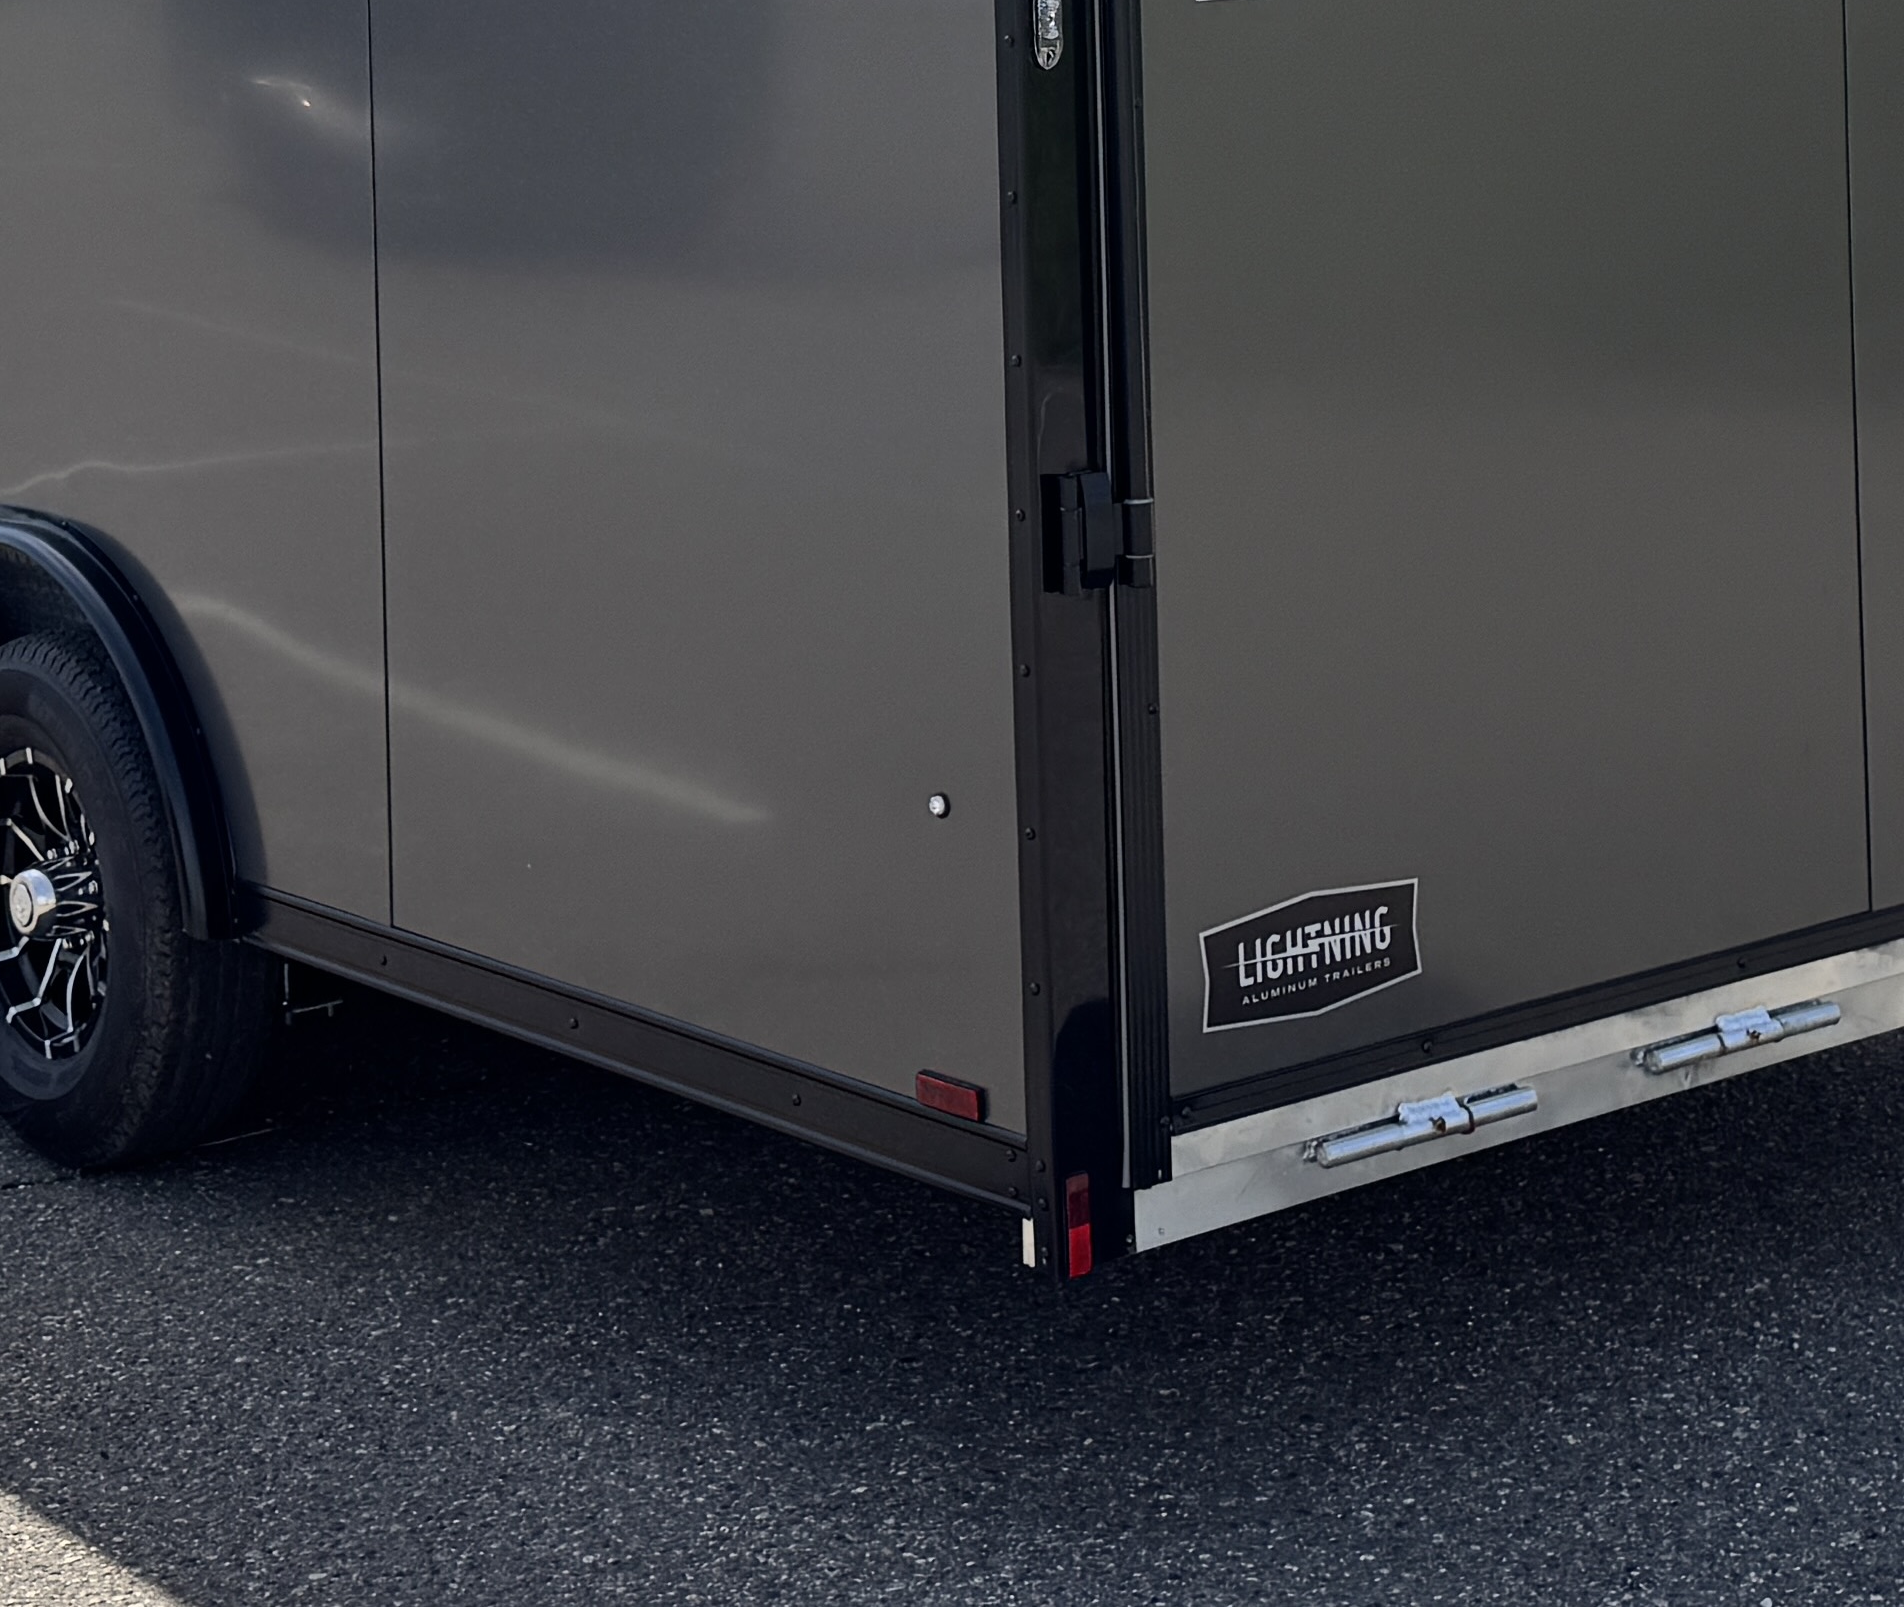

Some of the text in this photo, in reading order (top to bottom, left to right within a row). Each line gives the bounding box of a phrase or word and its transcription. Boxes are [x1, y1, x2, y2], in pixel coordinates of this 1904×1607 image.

[1238, 905, 1392, 988] LIGHTNING
[1241, 956, 1392, 1006] ALUMINUM TRAILERS
